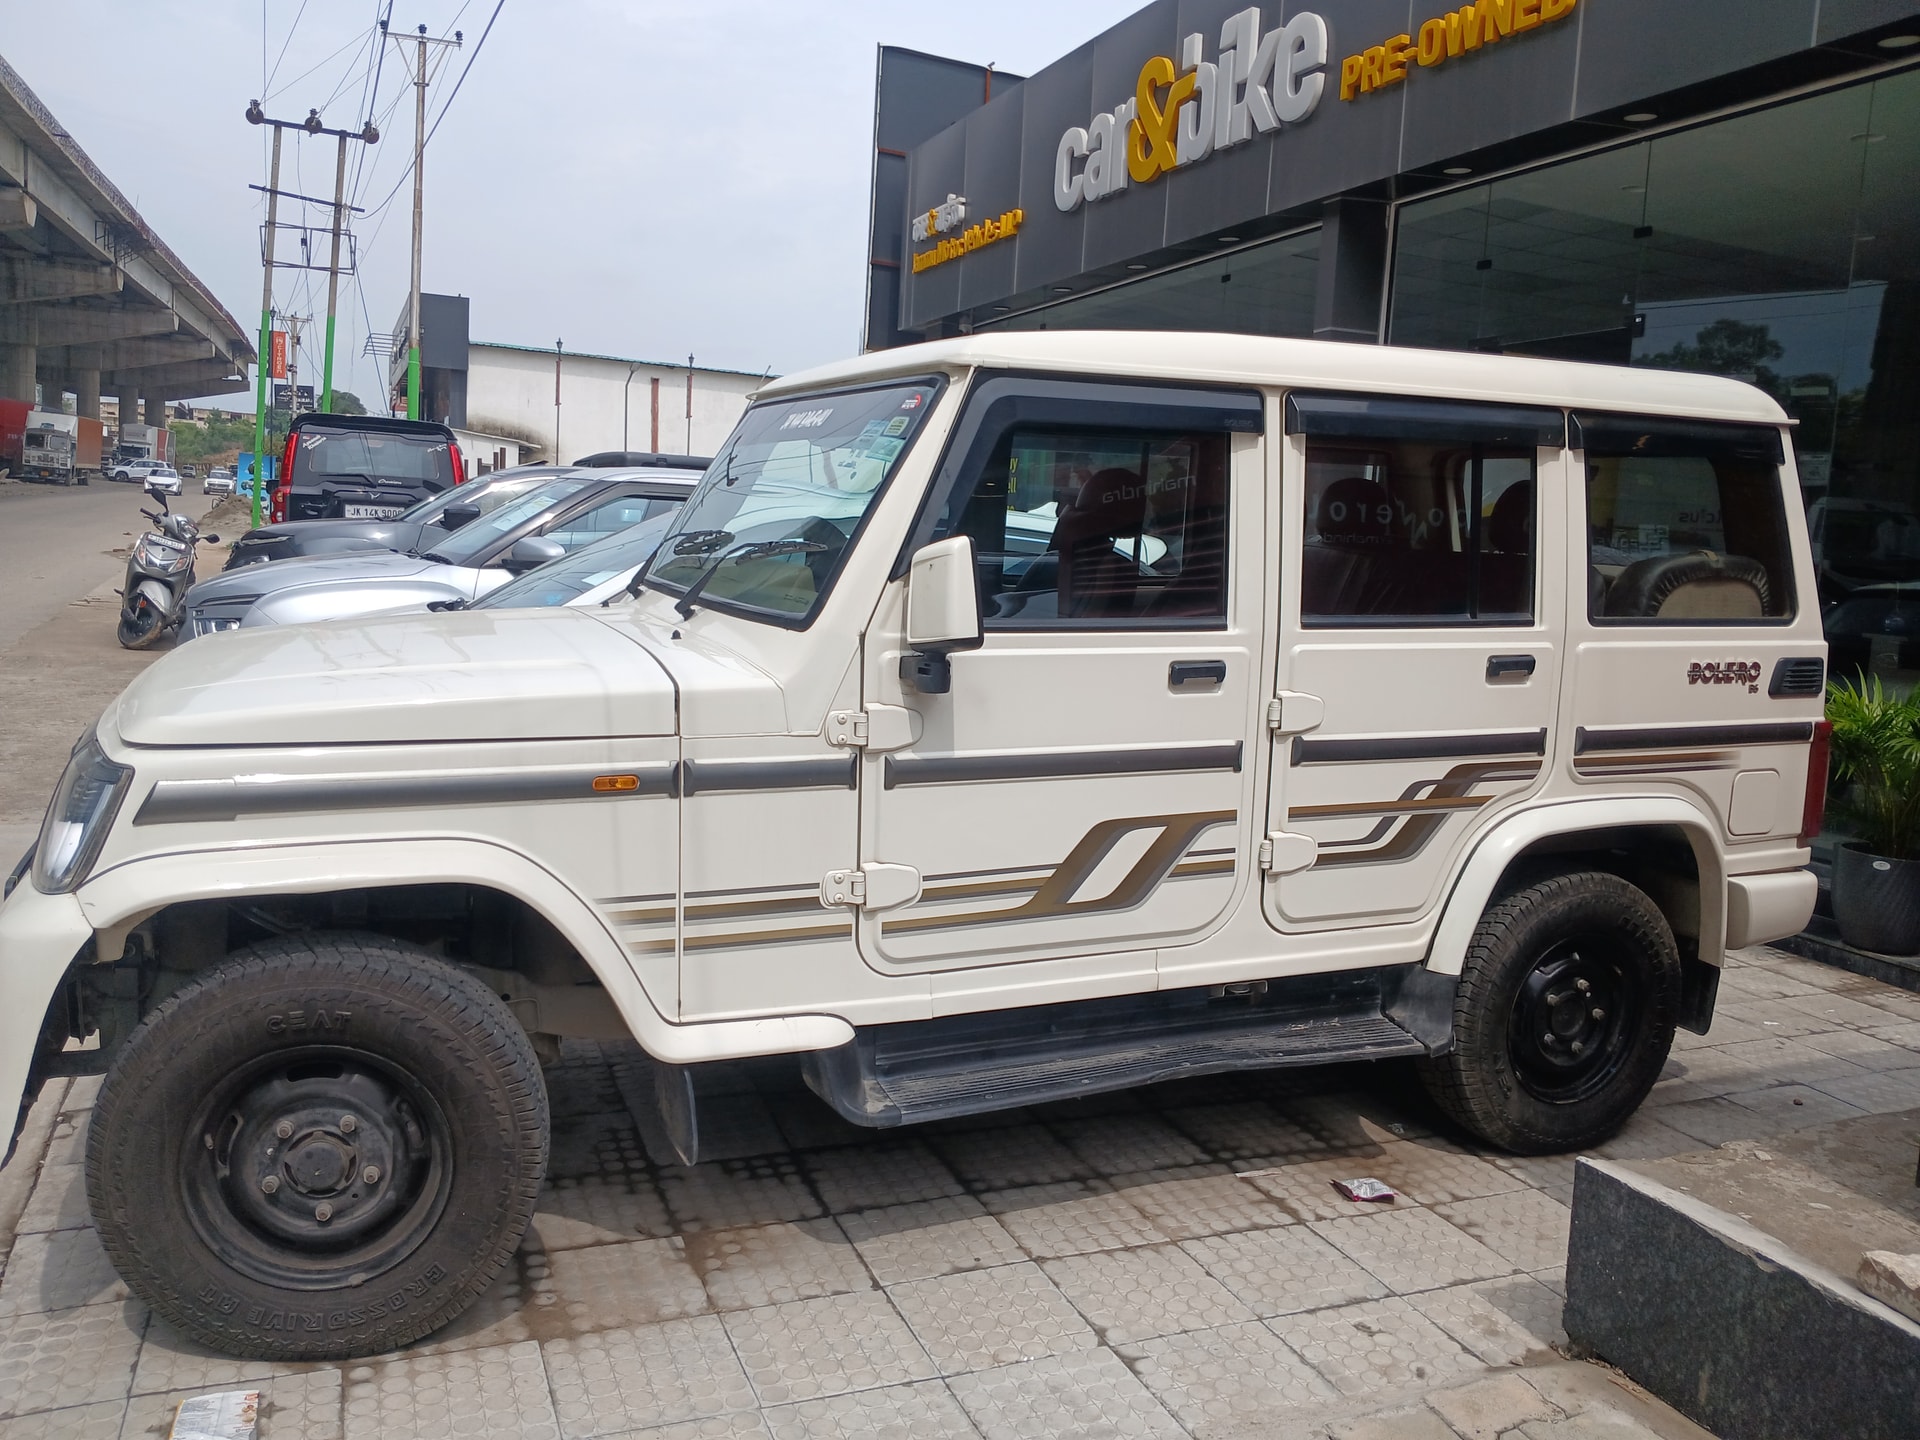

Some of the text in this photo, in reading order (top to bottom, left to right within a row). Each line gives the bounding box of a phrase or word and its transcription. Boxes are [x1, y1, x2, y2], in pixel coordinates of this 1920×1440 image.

[1340, 0, 1577, 100] PRE-OWNED
[1054, 6, 1328, 212] car&bike
[351, 507, 361, 517] JK
[1687, 661, 1761, 686] BOLERO
[266, 1009, 353, 1034] CEAT
[247, 1261, 448, 1332] CROSSDRIVE
